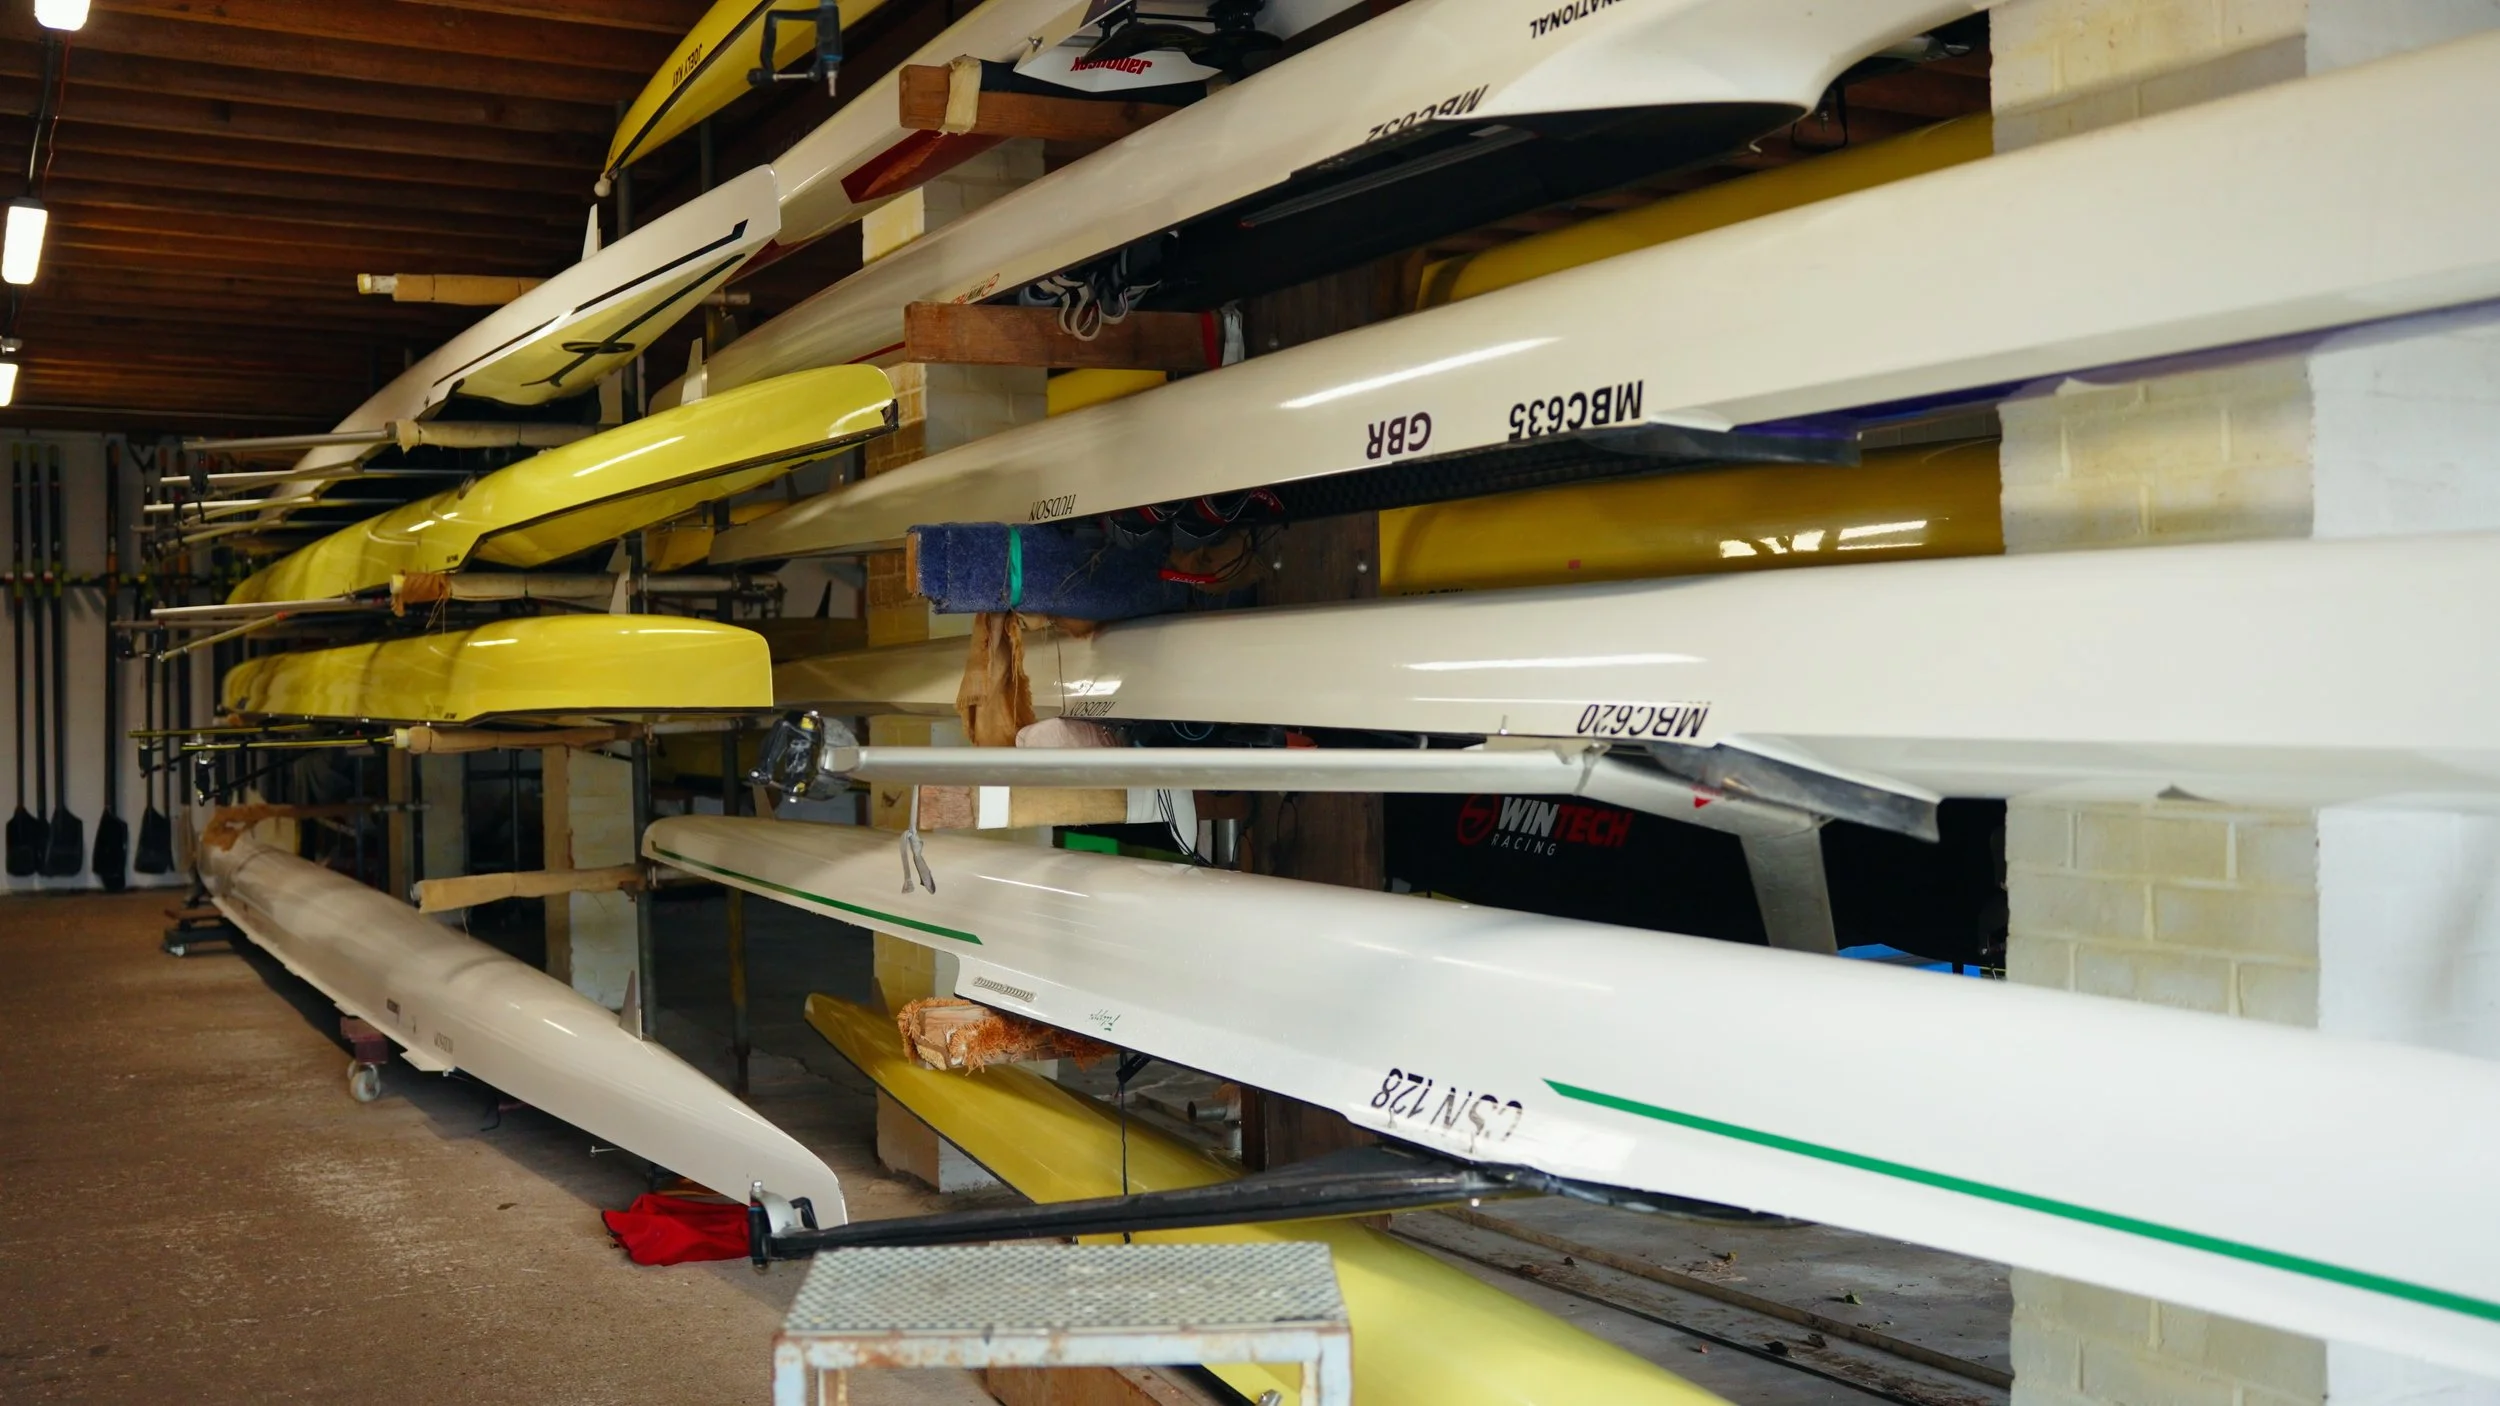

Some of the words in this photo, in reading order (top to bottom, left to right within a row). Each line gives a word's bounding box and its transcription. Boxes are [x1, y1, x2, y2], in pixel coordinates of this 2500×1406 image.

[671, 63, 684, 90] KAY
[683, 42, 703, 78] JOELY
[1508, 380, 1643, 442] MBC635
[1366, 411, 1432, 460] GBR
[1028, 494, 1077, 522] HUDSON
[1069, 701, 1116, 717] HUDSON
[1577, 703, 1709, 738] MBC620
[1498, 796, 1634, 847] WINTECH
[1491, 834, 1557, 856] RACING
[1371, 1068, 1433, 1119] 128
[1430, 1087, 1523, 1142] CSN
